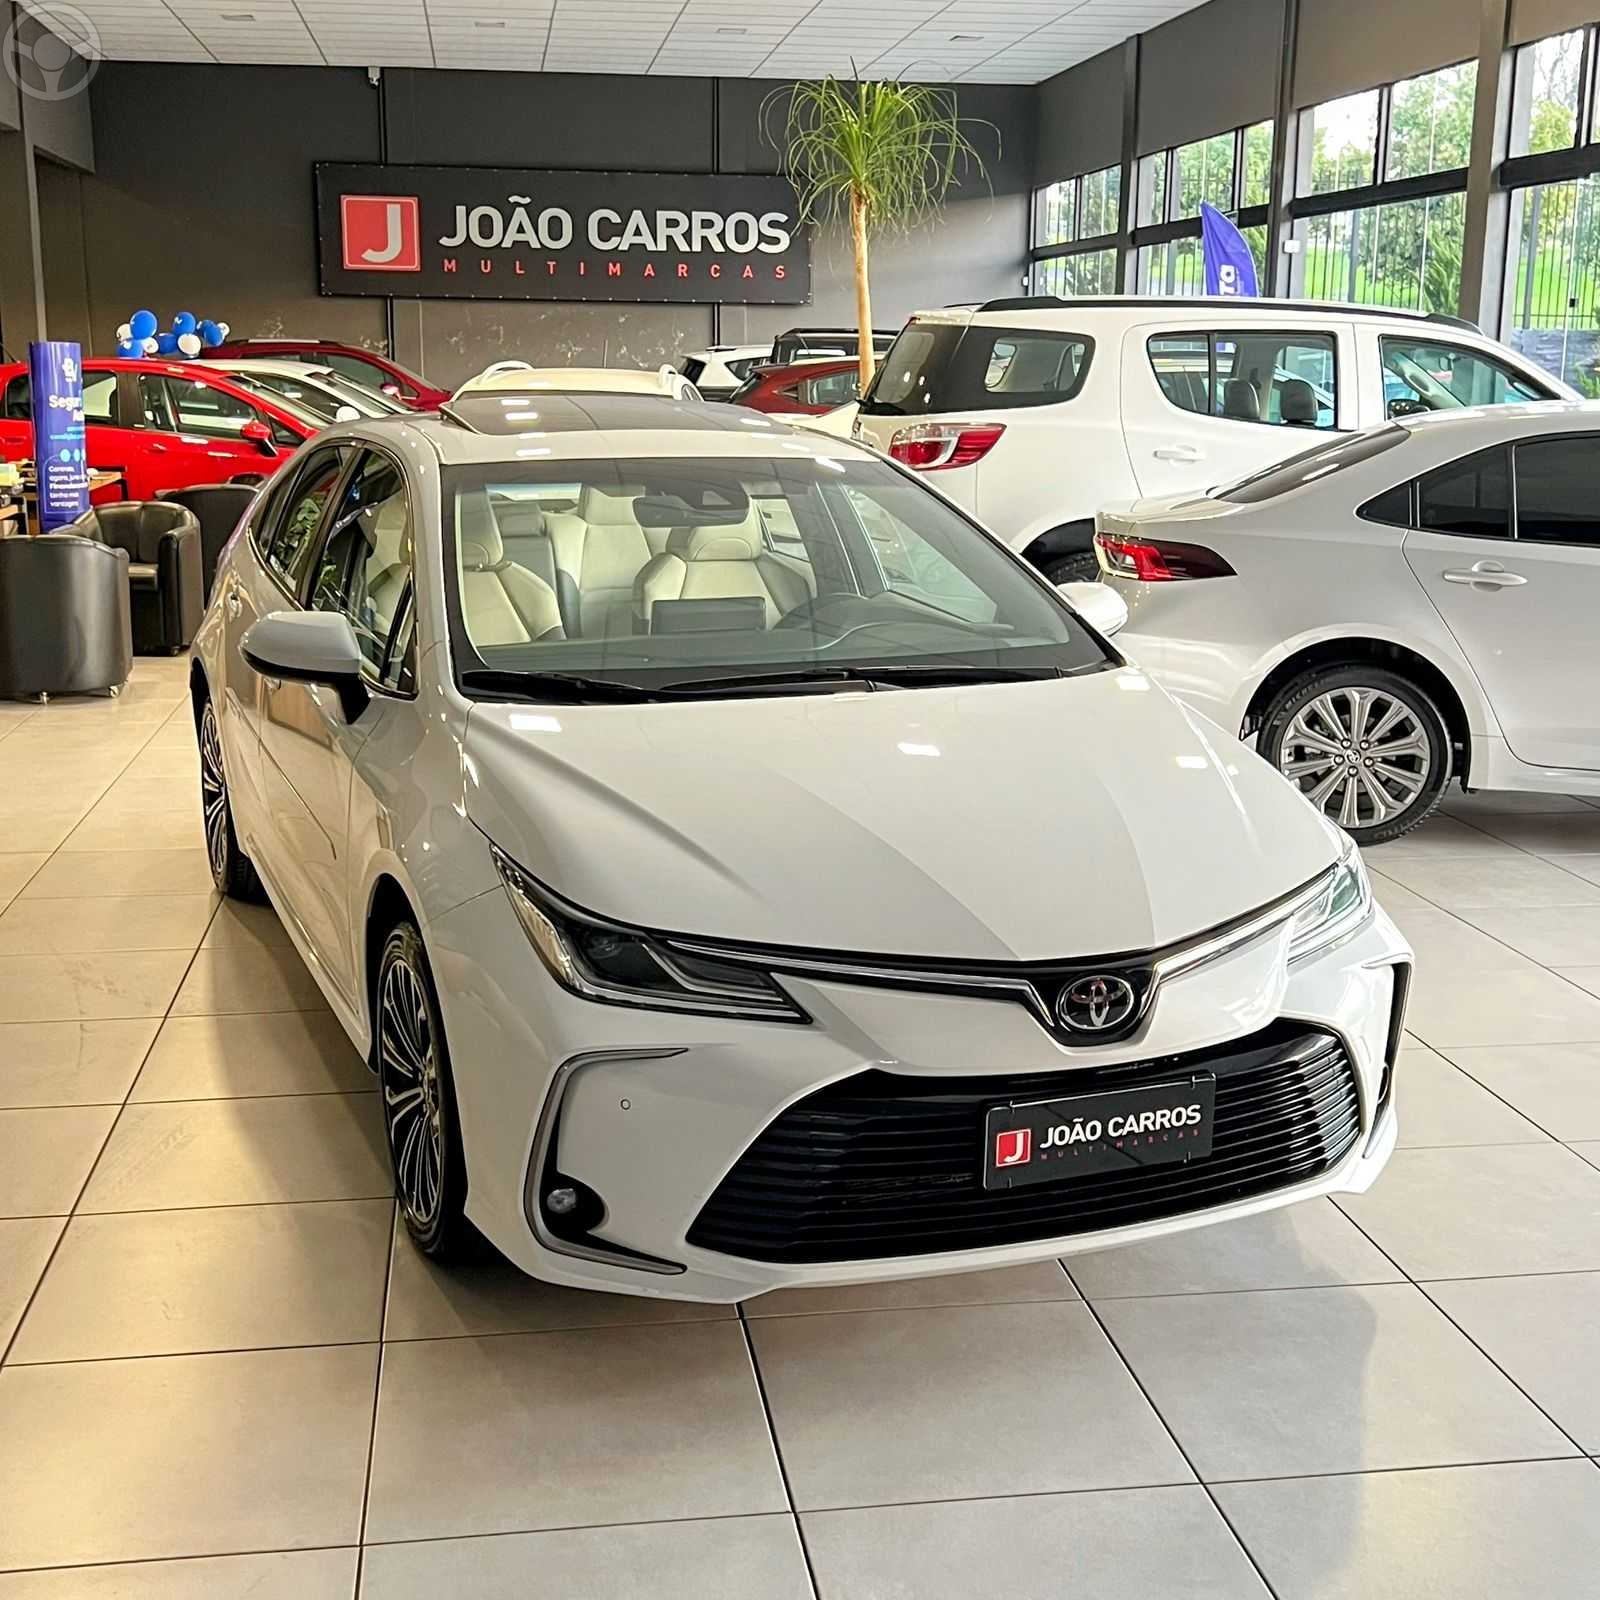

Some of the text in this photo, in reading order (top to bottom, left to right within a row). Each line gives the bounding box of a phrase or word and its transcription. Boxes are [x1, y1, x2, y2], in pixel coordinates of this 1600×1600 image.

[361, 203, 403, 263] J
[439, 195, 791, 254] JOÃO CARROS
[444, 258, 786, 279] MULTIMARCAS
[1003, 1131, 1025, 1163] J
[1039, 1103, 1202, 1149] JOÃO CARROS
